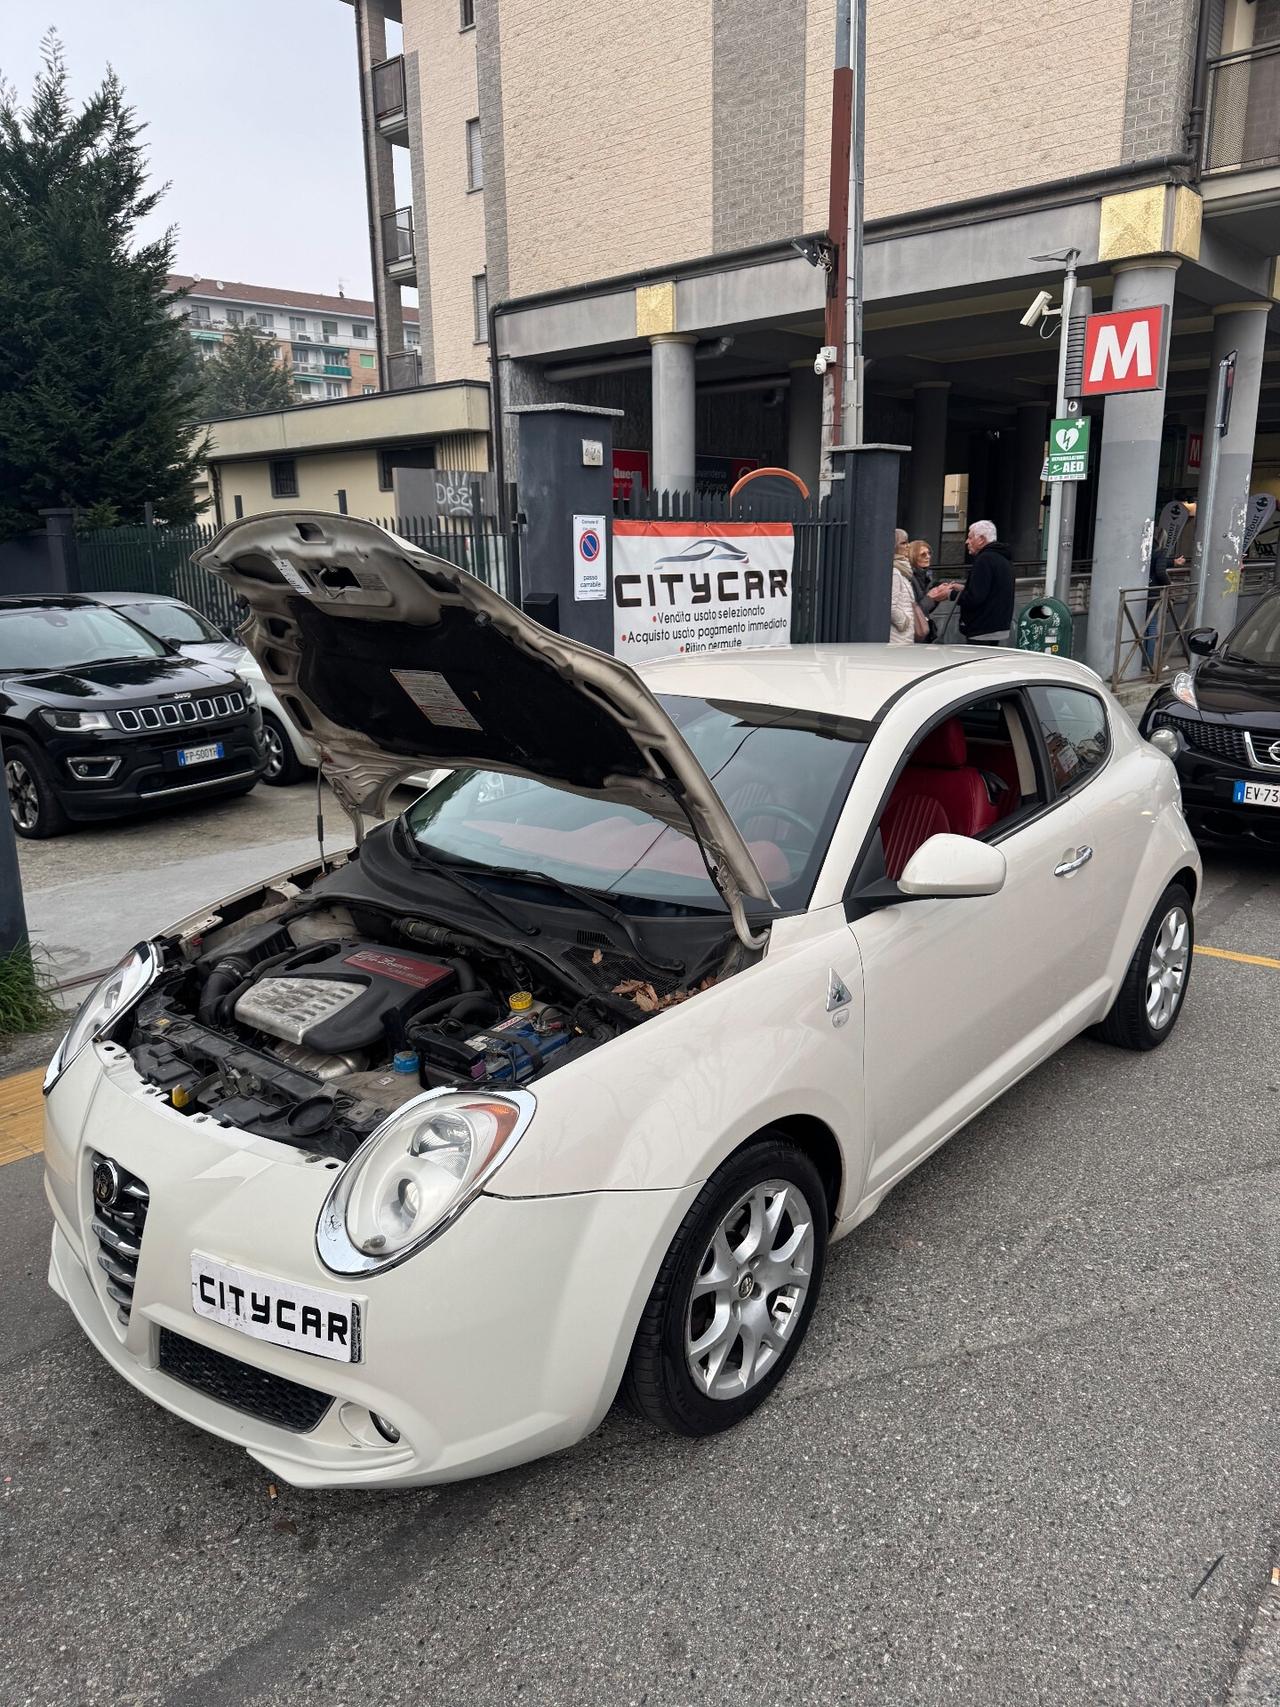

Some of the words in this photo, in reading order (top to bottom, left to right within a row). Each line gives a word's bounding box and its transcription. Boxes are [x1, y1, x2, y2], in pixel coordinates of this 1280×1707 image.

[1088, 320, 1152, 382] M
[1062, 461, 1084, 473] AED
[614, 569, 788, 608] CITYCAR
[628, 629, 670, 644] Acquisto
[672, 627, 696, 640] usato
[699, 622, 746, 640] pagamento
[747, 617, 788, 632] immediato
[657, 609, 692, 624] Vendita
[694, 608, 718, 622] usato
[718, 604, 766, 619] selezionato
[199, 1274, 348, 1346] CITYCAR
